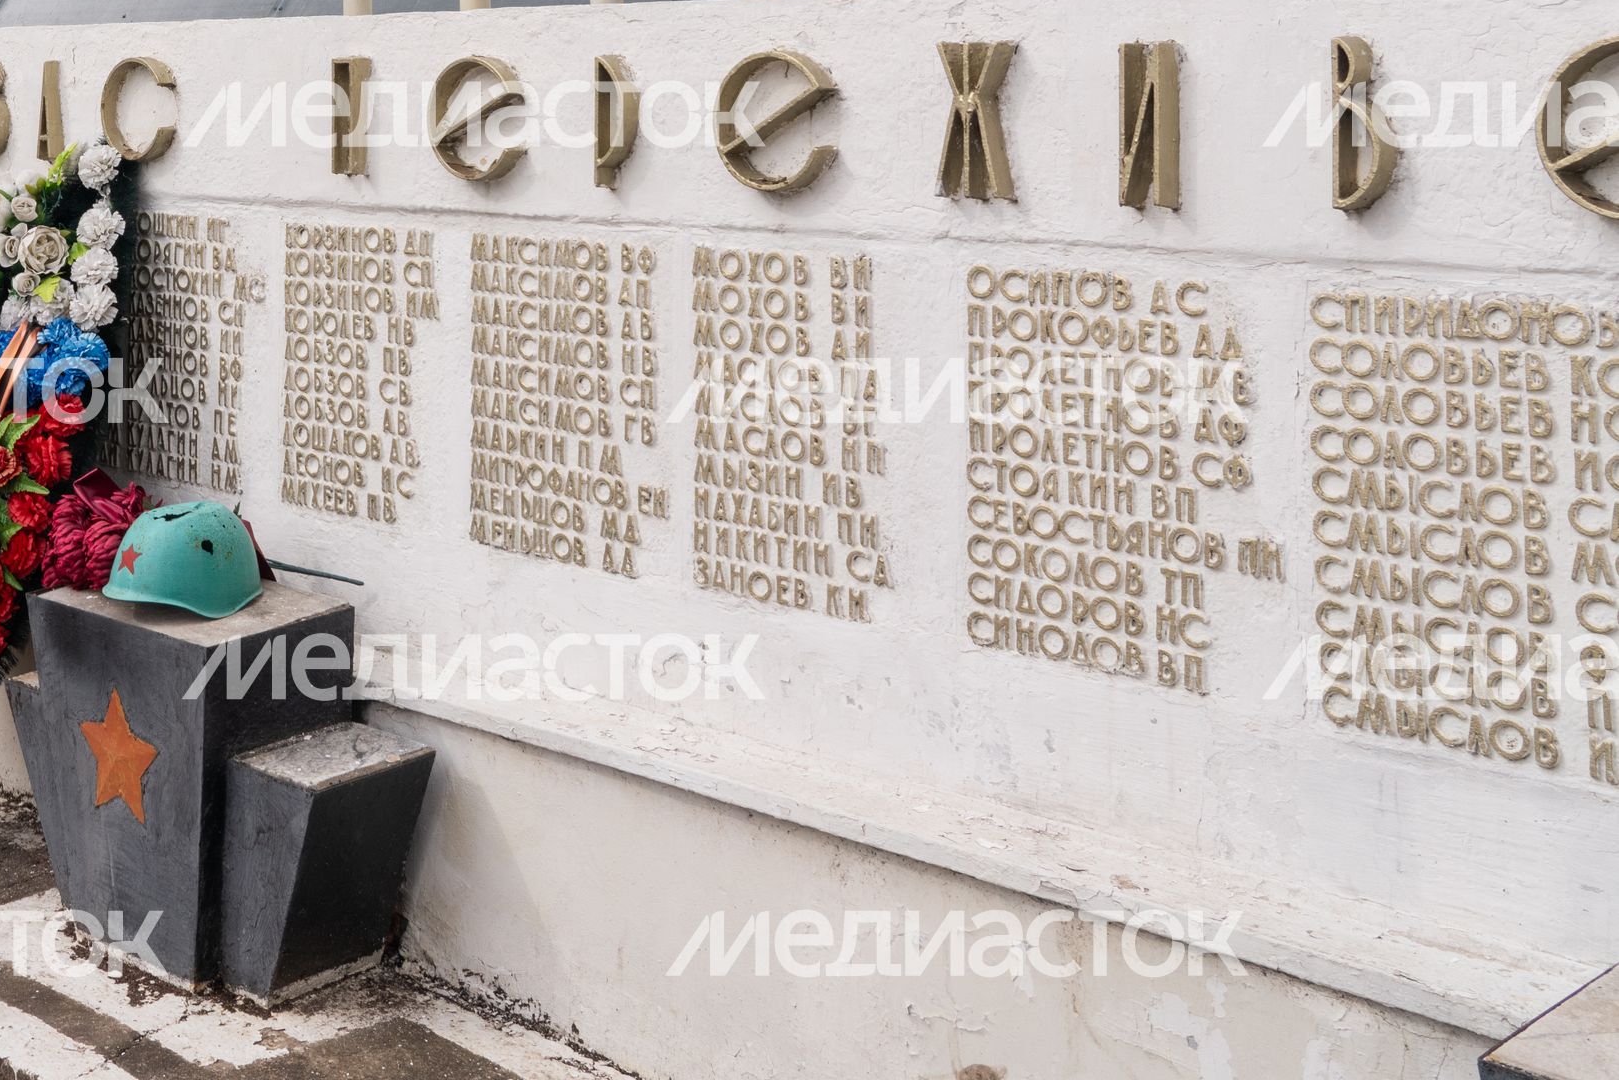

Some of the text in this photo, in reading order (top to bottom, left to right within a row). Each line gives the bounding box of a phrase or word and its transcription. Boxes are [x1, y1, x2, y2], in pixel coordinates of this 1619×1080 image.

[692, 246, 809, 286] МОХОВ
[966, 265, 1132, 311] ОСИПОВ
[692, 280, 809, 321] МОХОВ
[967, 304, 1179, 356] ПРОКОФЬЕВ
[693, 315, 811, 357] МОХОВ
[1308, 336, 1550, 392] СОЛОВЬЕВ
[1309, 379, 1554, 438] СОЛОВЬЕВ
[694, 419, 825, 466] МАСЛОВ
[968, 417, 1179, 481] ПРОЛЕТНОВ
[1309, 423, 1556, 484] СОЛОВЬЕВ
[966, 456, 1134, 514] СТОЯКИН
[1311, 466, 1549, 530] СМЫСЛОВ
[966, 533, 1145, 597] СОКОЛОВ
[1312, 510, 1550, 576] СМЫСЛОВ
[967, 571, 1145, 637] СИДОРОВ
[1313, 554, 1552, 624] СМЫСЛОВ
[1322, 685, 1560, 770] СМЫСЛОВ
